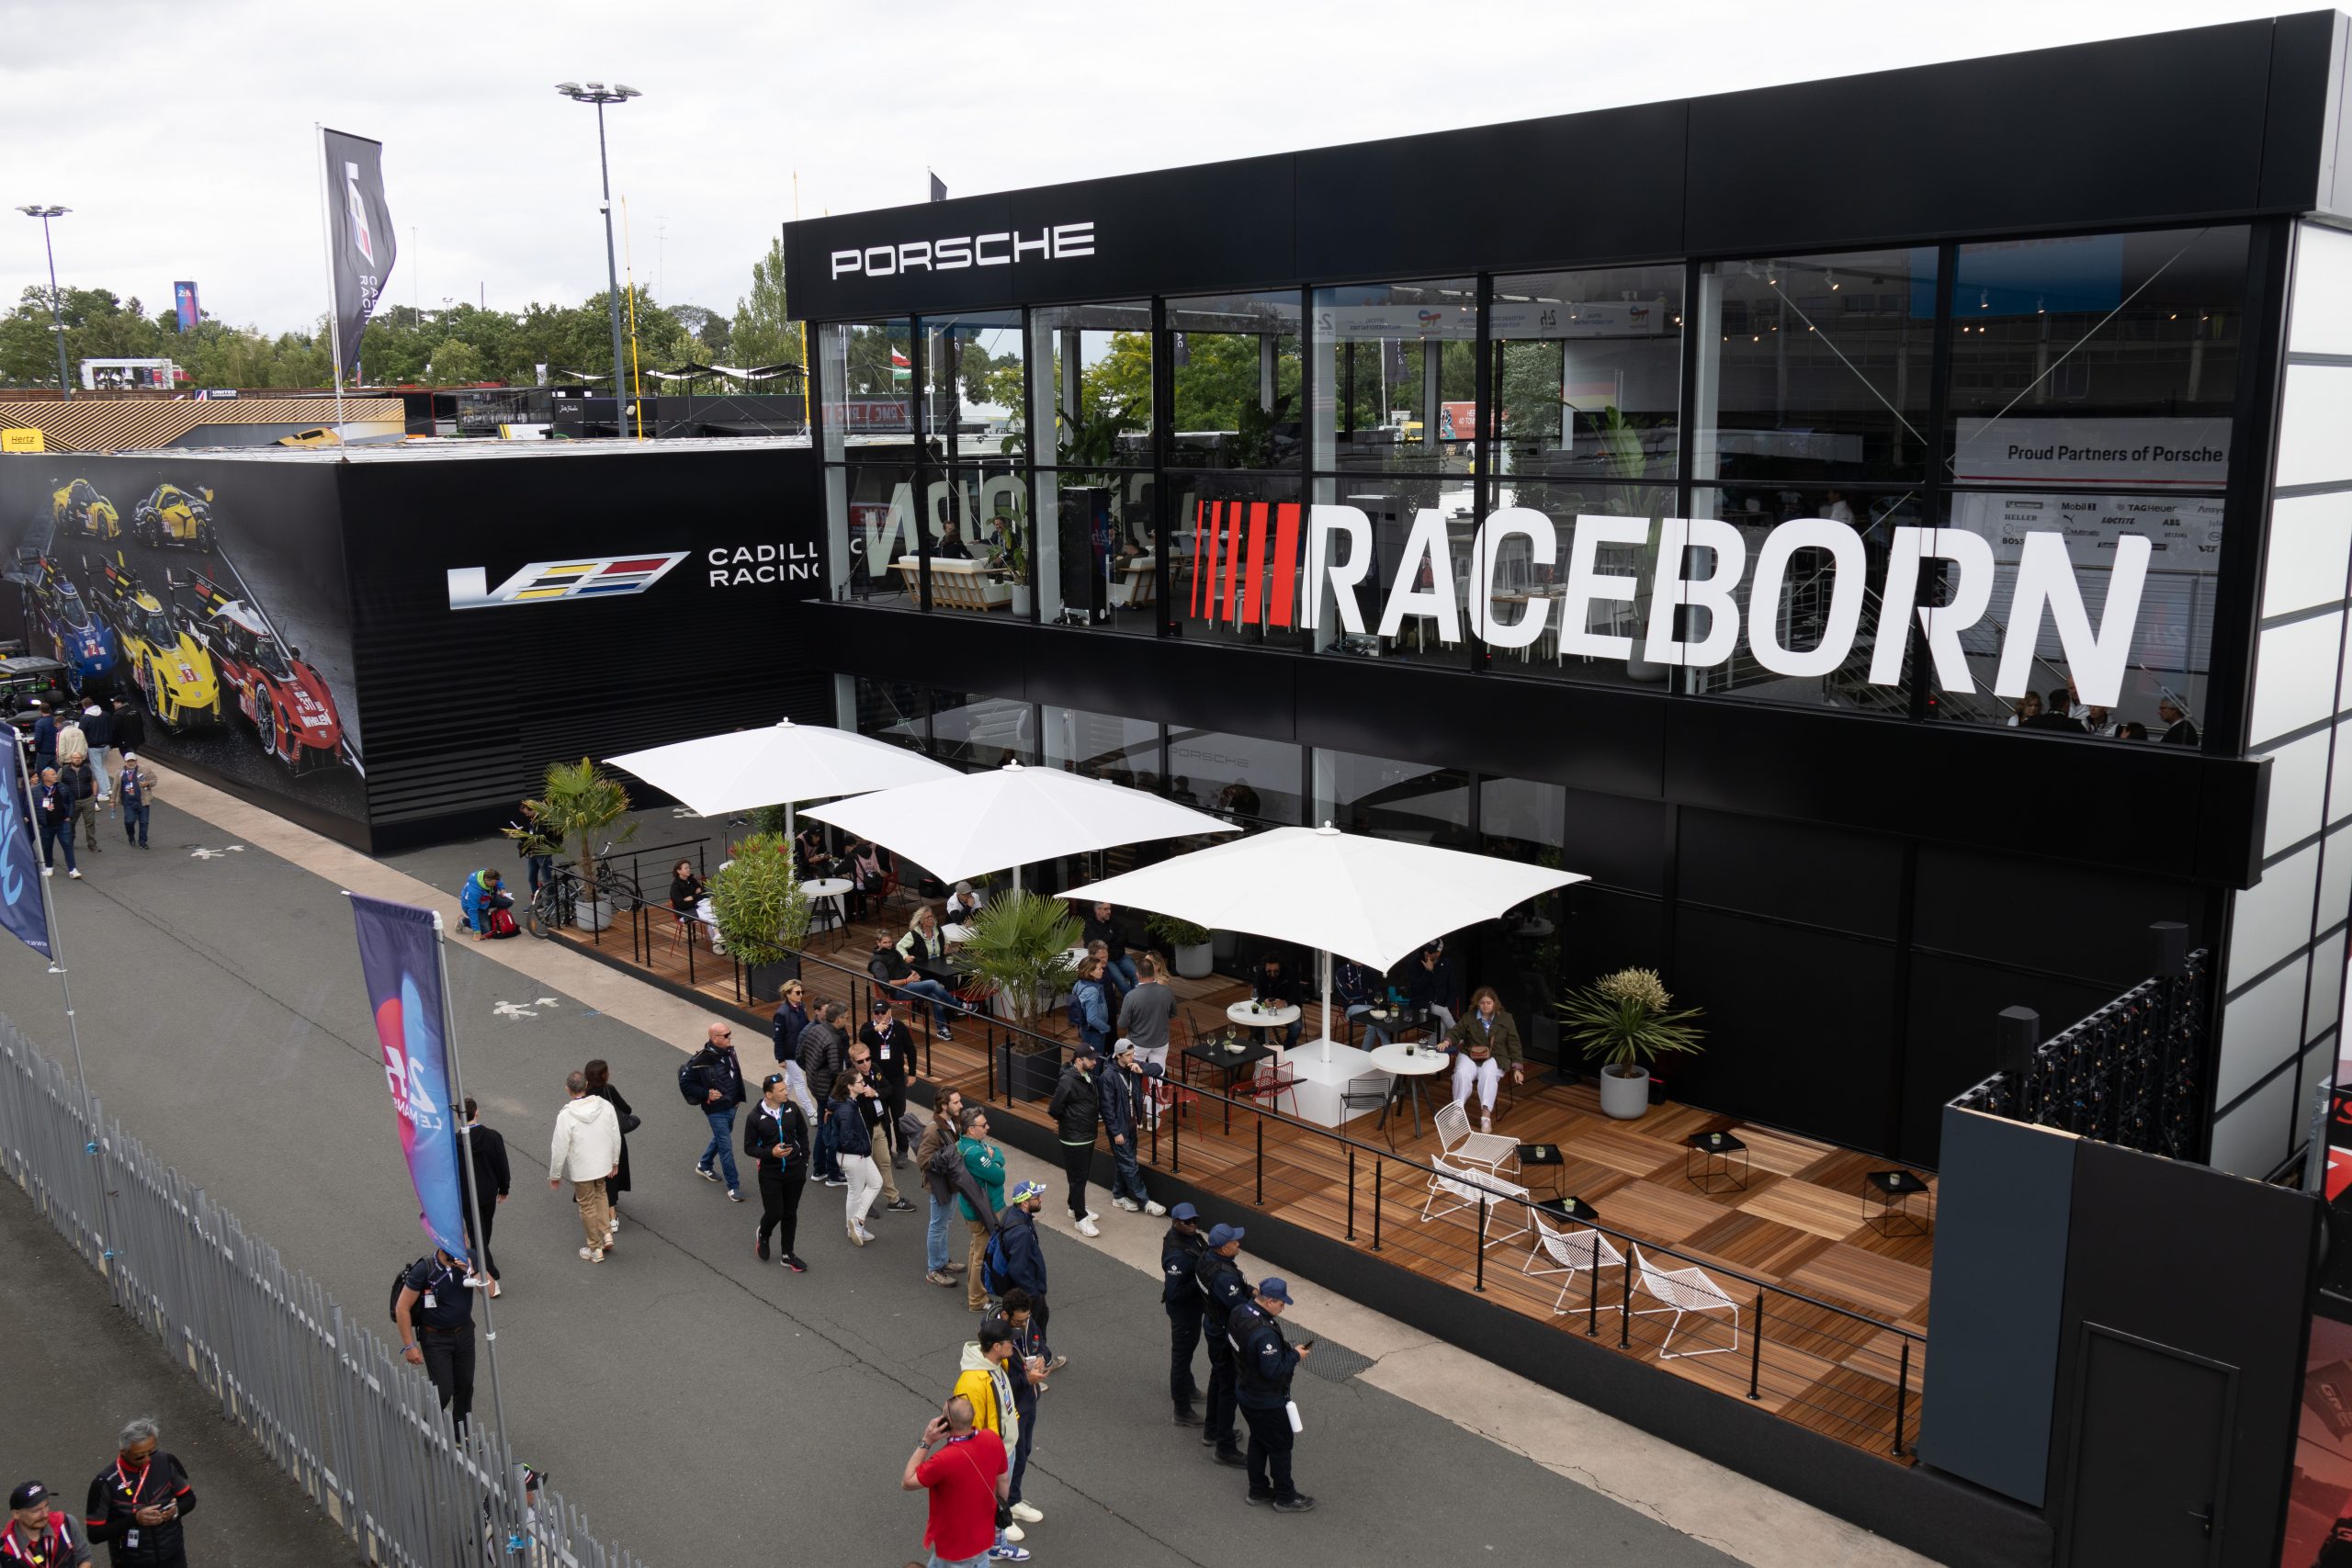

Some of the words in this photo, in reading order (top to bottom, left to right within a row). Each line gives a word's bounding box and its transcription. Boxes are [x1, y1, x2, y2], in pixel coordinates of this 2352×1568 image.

[831, 221, 1095, 280] PORSCHE
[2007, 445, 2054, 460] Proud
[2058, 445, 2128, 461] Partners
[2132, 446, 2151, 461] of
[2153, 446, 2223, 463] Porsche
[2101, 517, 2136, 525] LOCTITE
[1300, 503, 2154, 709] RACEBORN
[91, 645, 97, 656] 2
[185, 669, 194, 682] 3
[300, 696, 315, 711] 311
[300, 711, 333, 728] WHELEN
[1170, 746, 1250, 769] PORSCHE
